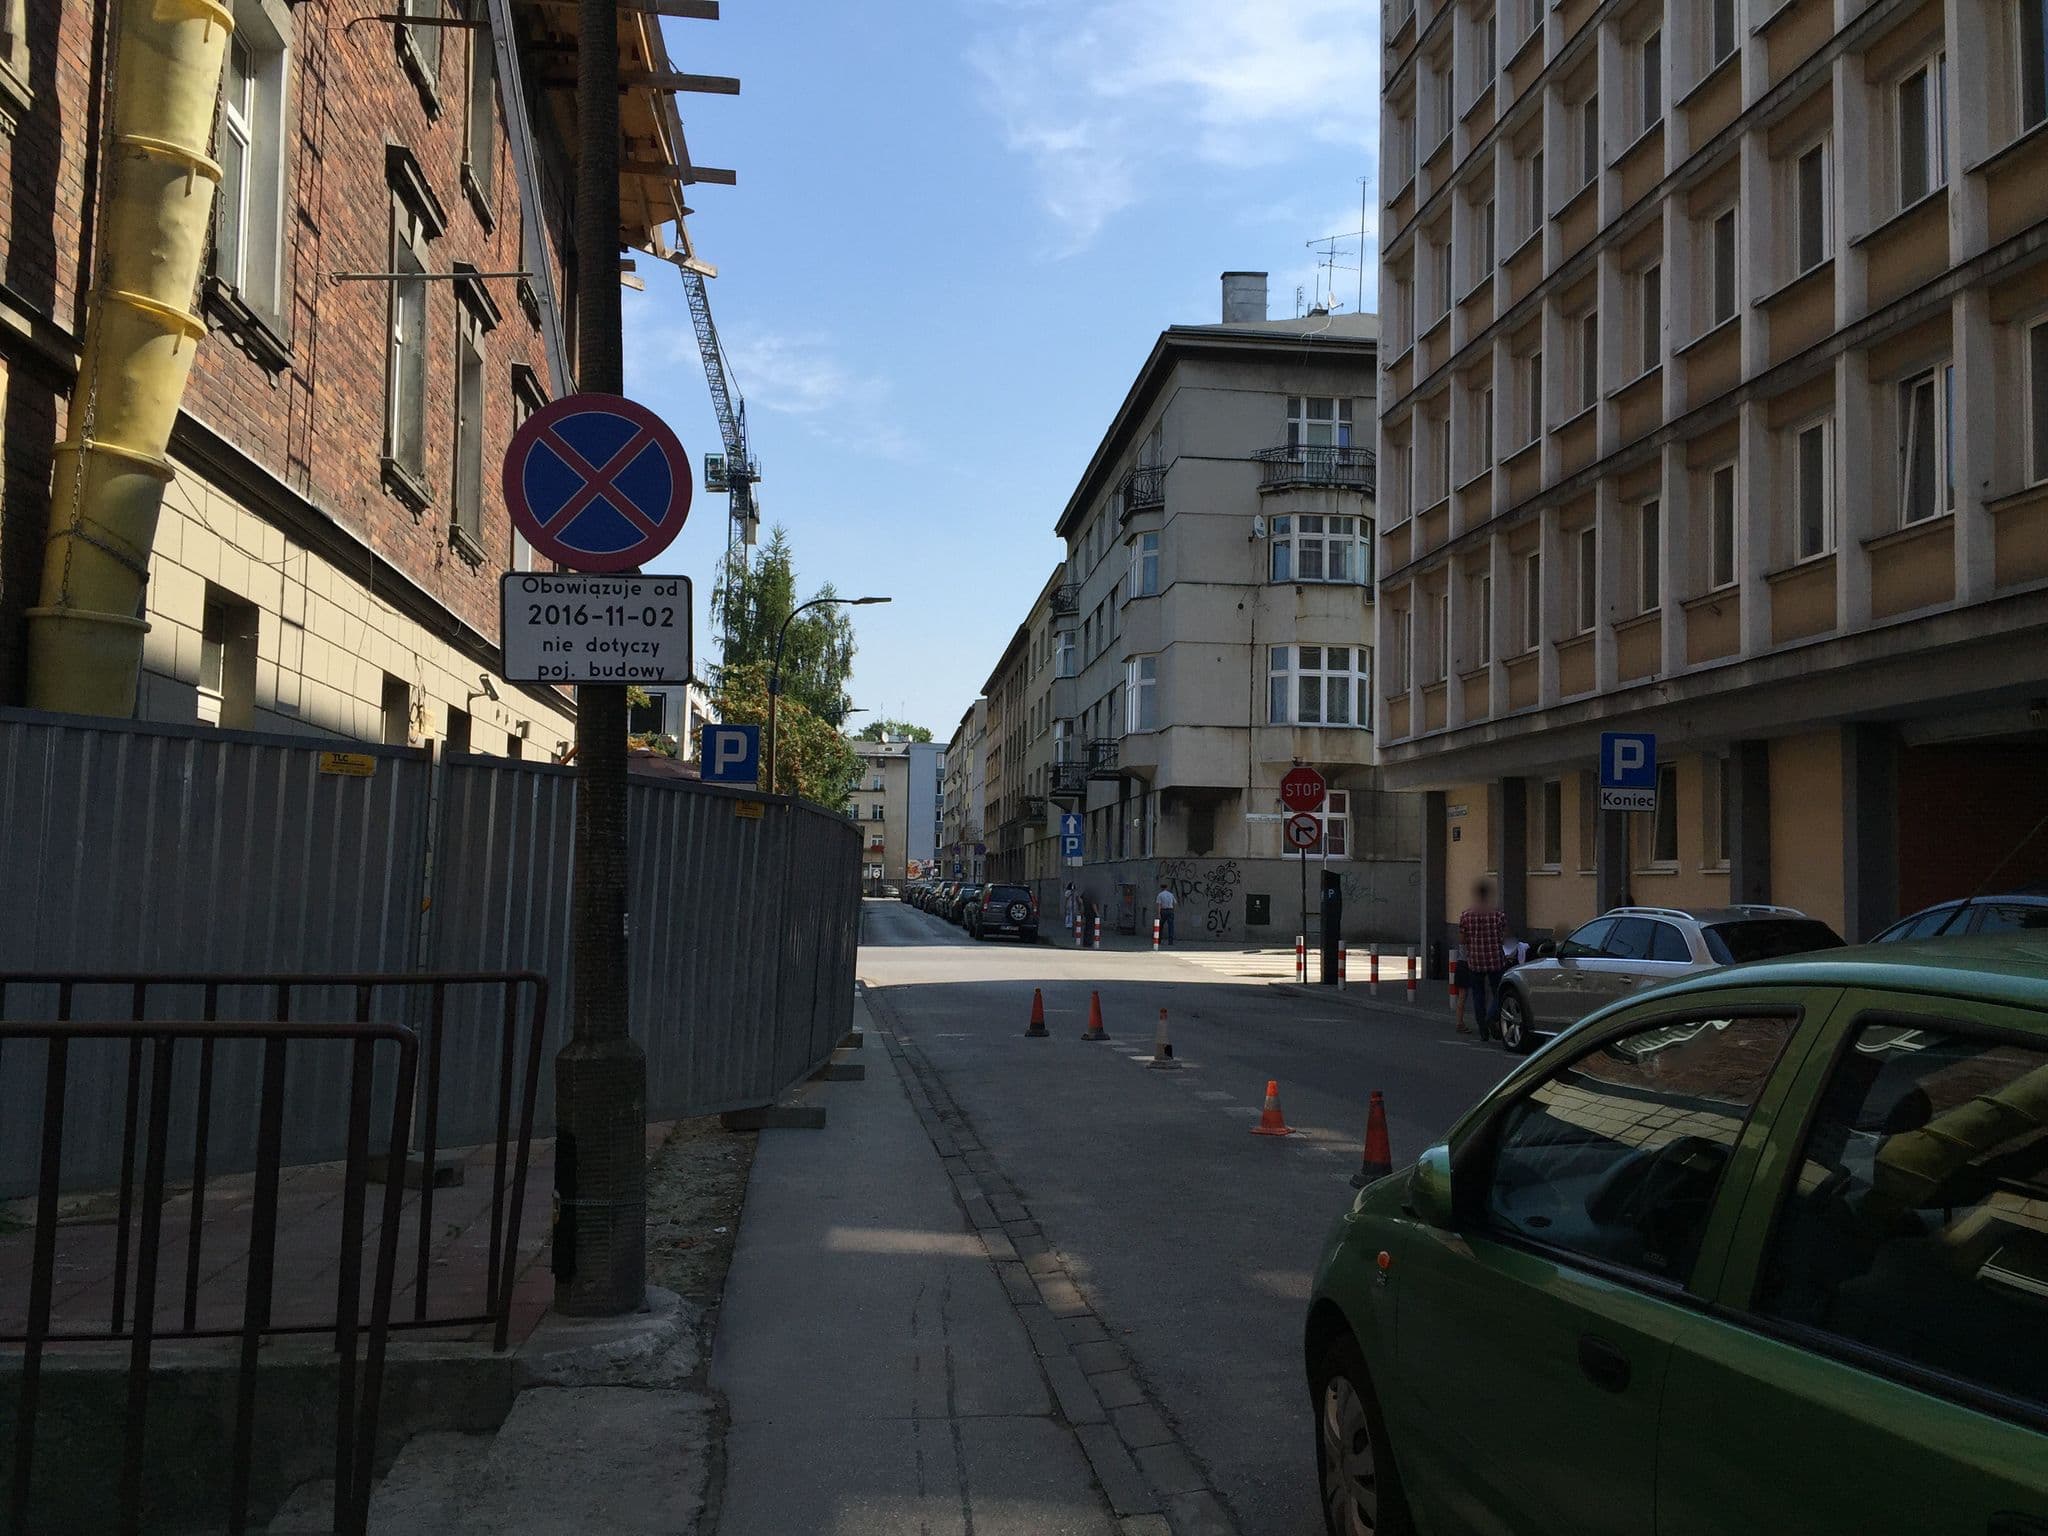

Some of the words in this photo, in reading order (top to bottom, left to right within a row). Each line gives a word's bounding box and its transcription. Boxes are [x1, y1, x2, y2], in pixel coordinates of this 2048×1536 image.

[522, 577, 642, 599] Obowiązuje
[654, 581, 678, 597] od
[528, 603, 674, 628] 2016-11-02
[543, 636, 574, 652] nie
[586, 637, 661, 657] dotyczy
[538, 661, 576, 681] poj.
[590, 661, 665, 681] budowy
[714, 730, 748, 775] P
[1613, 738, 1645, 781] P
[1285, 782, 1321, 797] STOP
[1603, 792, 1655, 807] Koniec
[1066, 837, 1079, 854] P
